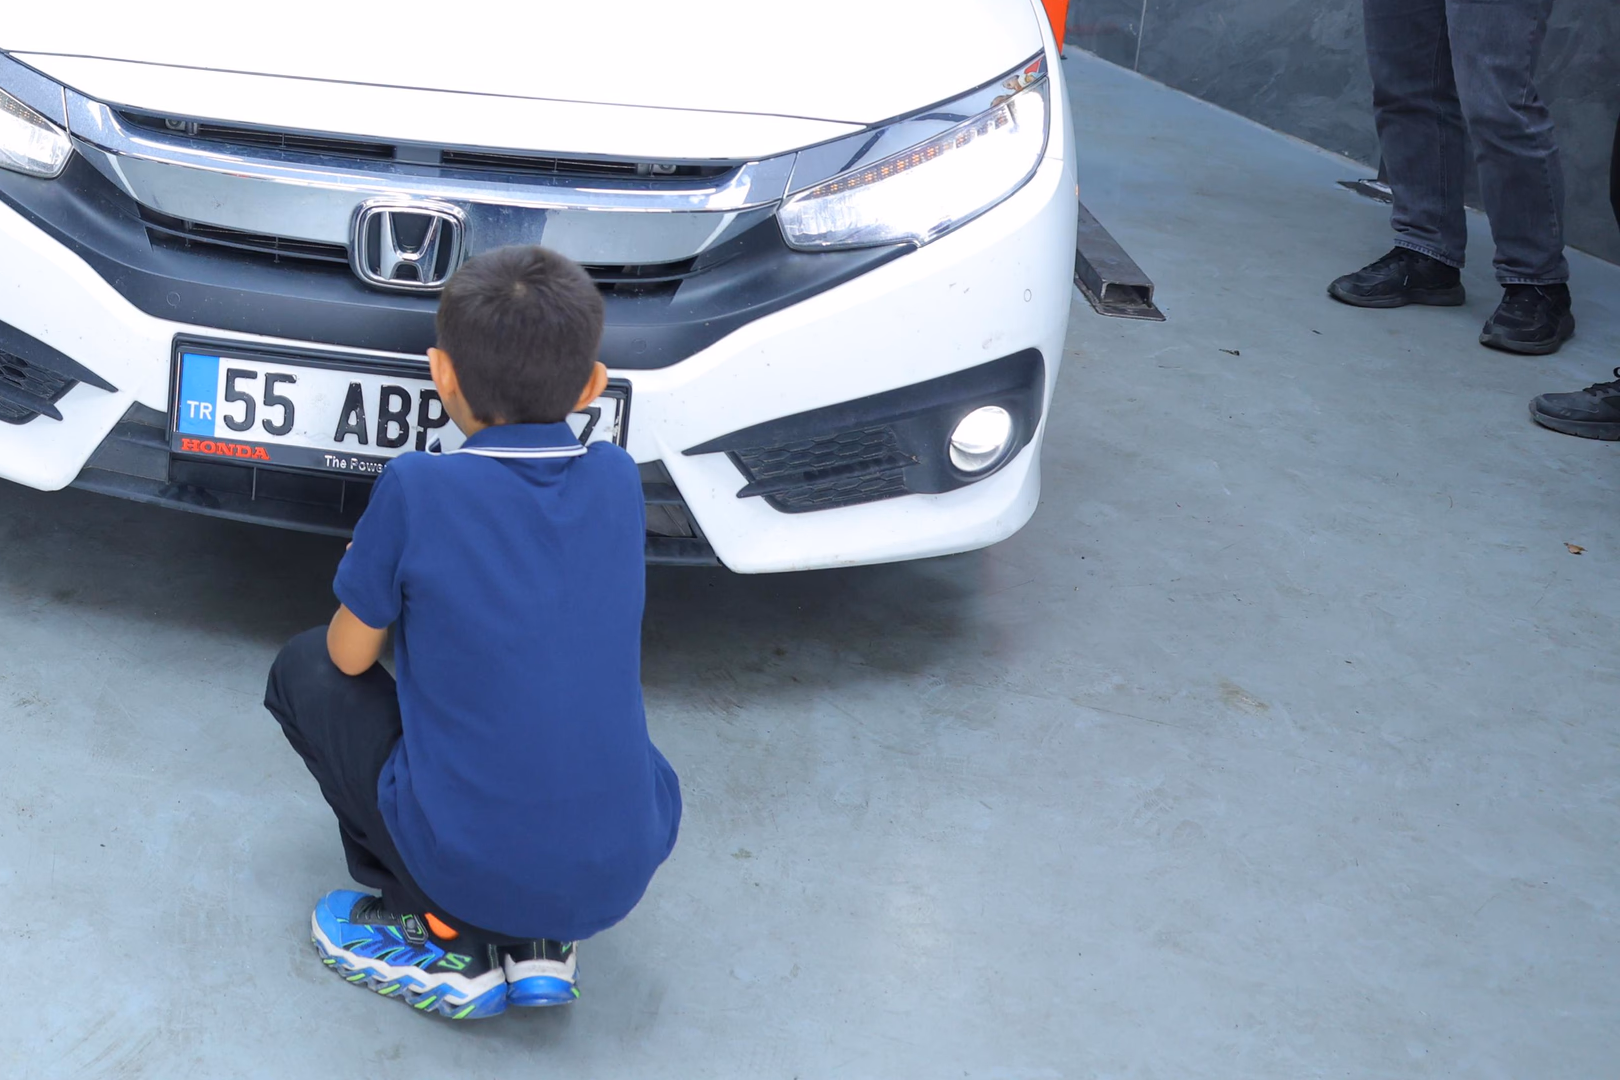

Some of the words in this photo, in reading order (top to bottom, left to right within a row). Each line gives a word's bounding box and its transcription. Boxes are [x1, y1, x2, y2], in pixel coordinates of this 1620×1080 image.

[187, 400, 212, 420] TR
[223, 367, 297, 436] 55
[181, 438, 270, 460] HONDA
[324, 454, 347, 469] The
